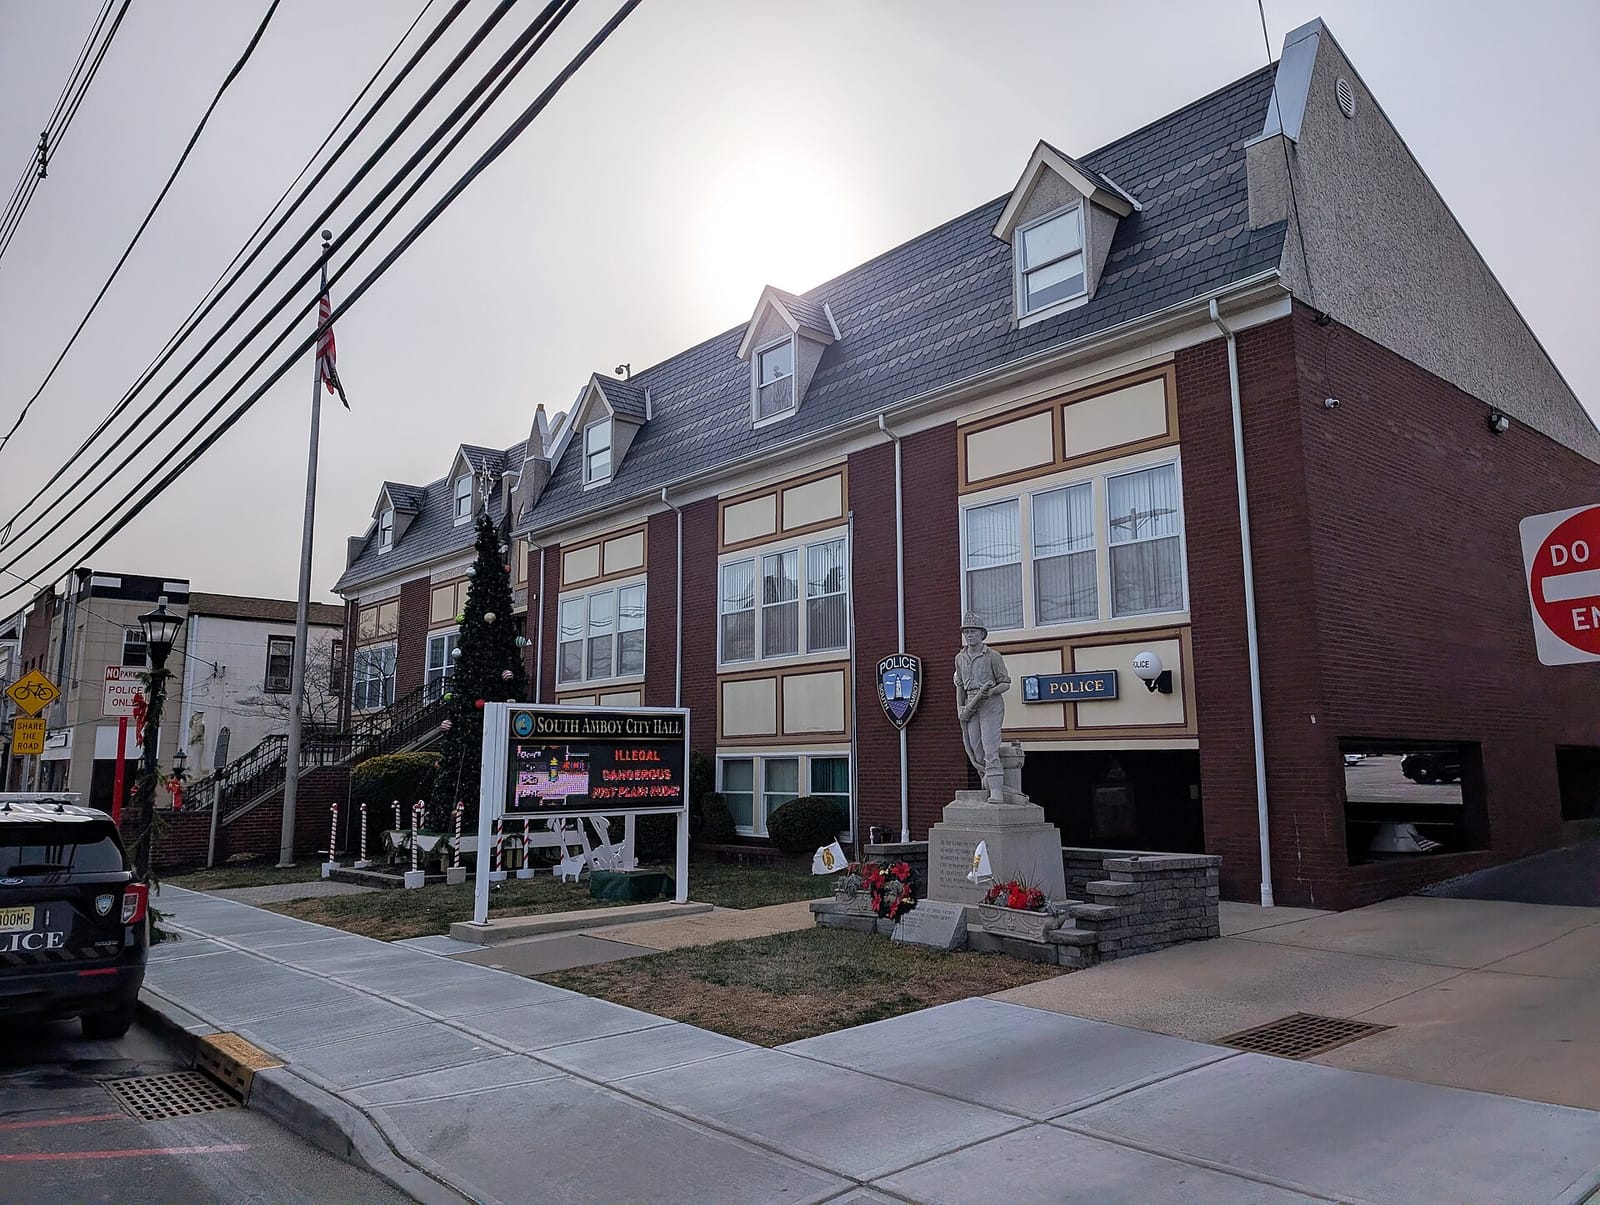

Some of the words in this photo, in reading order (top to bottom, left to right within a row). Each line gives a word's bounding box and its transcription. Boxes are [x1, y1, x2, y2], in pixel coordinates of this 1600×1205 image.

[1550, 540, 1590, 567] DO
[880, 656, 917, 675] POLICE
[106, 667, 119, 679] NO
[108, 686, 143, 695] POLICE
[1049, 679, 1105, 694] POLICE
[111, 698, 137, 707] ONL
[537, 716, 579, 733] SOUTH
[581, 717, 624, 734] AMBOY
[626, 718, 651, 734] CITY
[653, 720, 682, 735] HALL
[17, 742, 39, 750] ROAD
[614, 749, 661, 761] ILLEGAL
